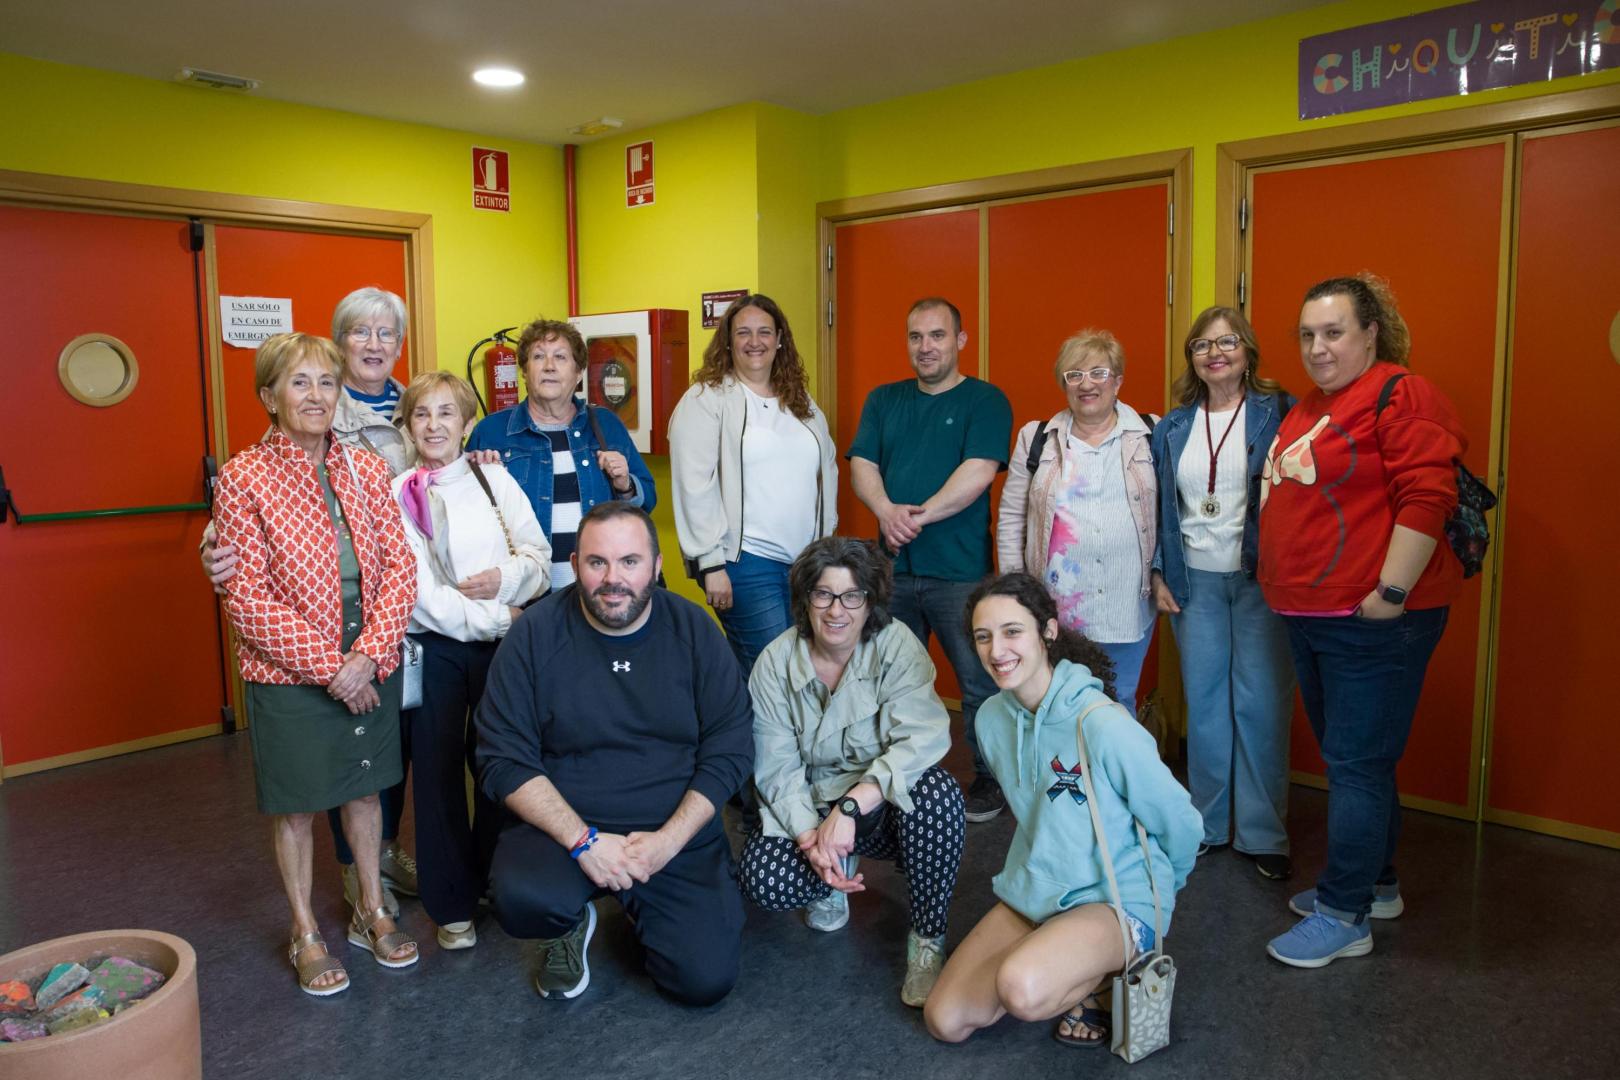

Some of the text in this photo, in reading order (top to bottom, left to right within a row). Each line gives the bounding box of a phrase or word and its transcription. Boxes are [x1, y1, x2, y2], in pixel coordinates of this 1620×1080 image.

[475, 194, 509, 209] EXTINTOR
[231, 302, 255, 310] USAR
[245, 317, 269, 325] CASO
[228, 331, 272, 340] EMERGEN
